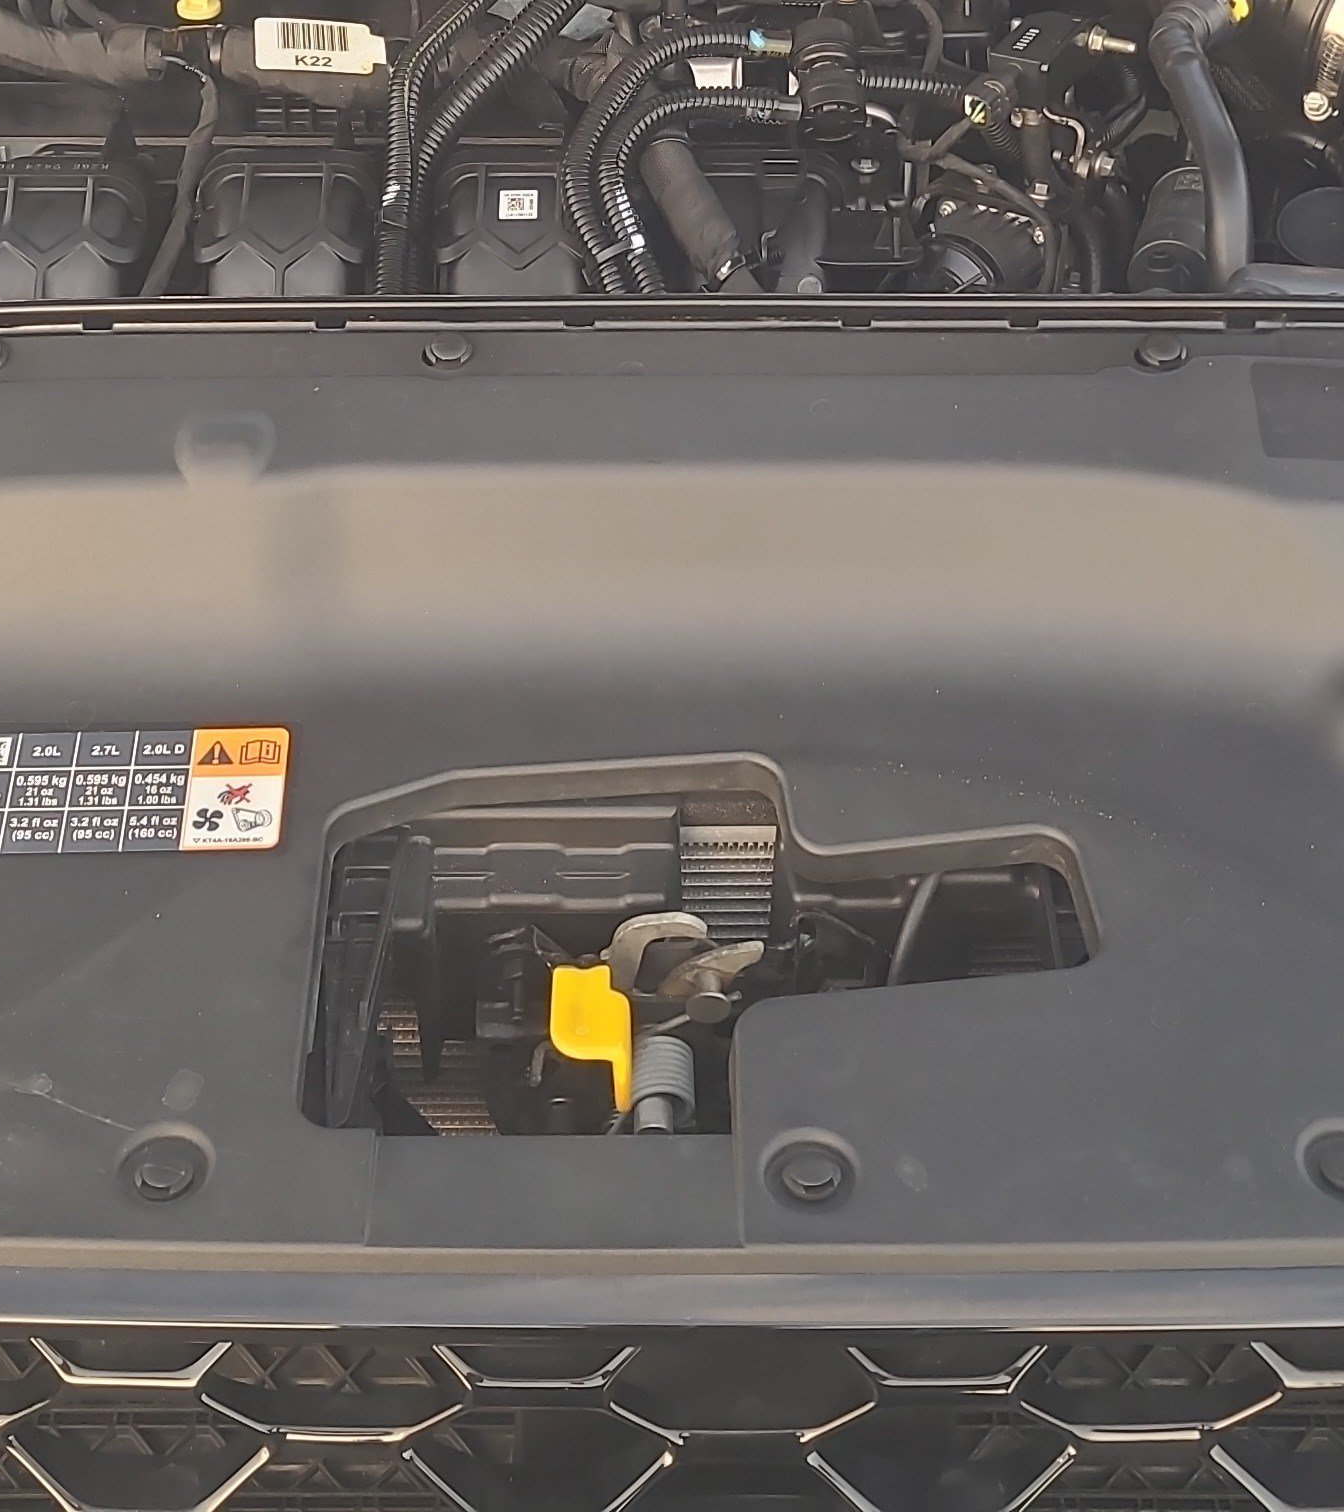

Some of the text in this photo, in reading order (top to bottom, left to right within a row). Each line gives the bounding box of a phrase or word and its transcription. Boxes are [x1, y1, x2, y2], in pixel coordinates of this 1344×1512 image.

[295, 55, 332, 67] K22
[32, 746, 61, 757] 2.0L
[90, 745, 120, 756] 2.7L
[142, 744, 185, 755] 2.0L D
[16, 775, 67, 788] 0.595 kg
[75, 774, 127, 787] 0.595 kg
[134, 773, 186, 786] 0.454 kg
[25, 787, 54, 796] 21 oz
[85, 786, 98, 795] 21
[145, 785, 172, 794] 16 oz
[18, 797, 58, 806] 1.31 lbs
[78, 796, 118, 805] 1.31 lbs
[137, 795, 177, 804] 1.00 lbs
[9, 817, 59, 828] 3.2 fl oz
[70, 816, 119, 827] 3.2 fl oz
[129, 816, 178, 826] 5.4 fl oz
[11, 830, 54, 842] (95 cc)
[72, 829, 115, 842] (95 cc)
[128, 828, 178, 841] (160 cc)
